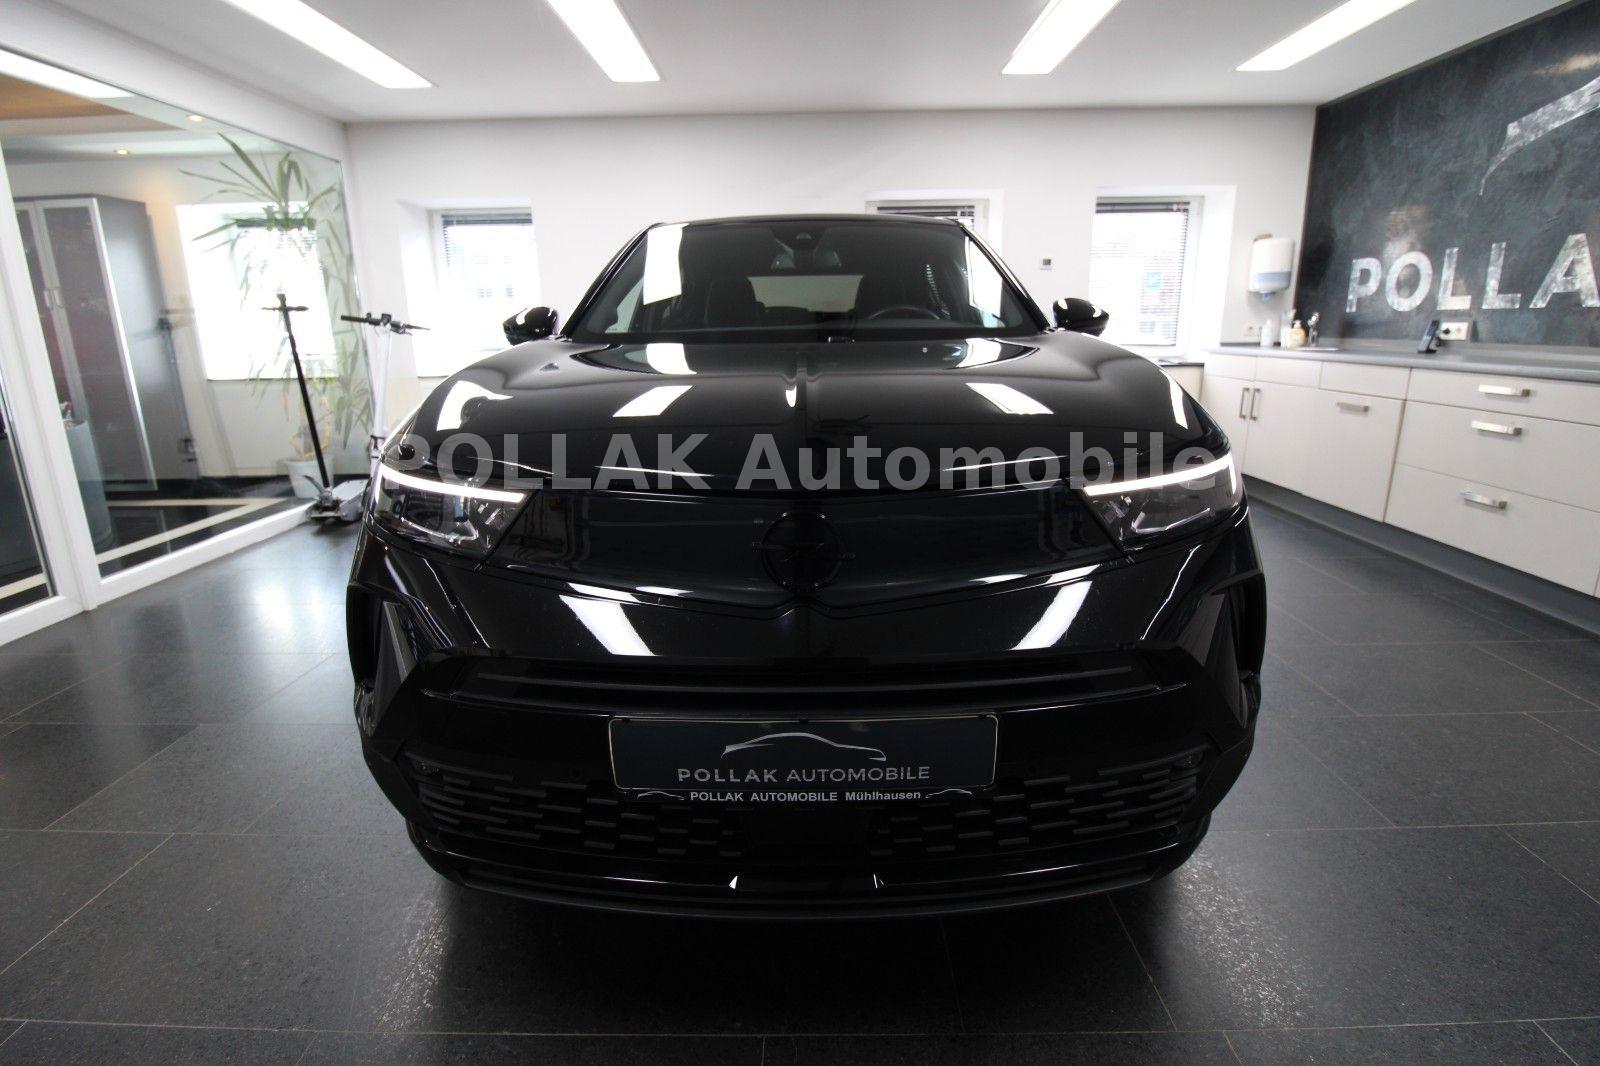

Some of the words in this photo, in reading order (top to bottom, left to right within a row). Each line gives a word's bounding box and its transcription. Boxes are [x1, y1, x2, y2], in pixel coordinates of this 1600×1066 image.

[1346, 233, 1600, 312] POLLA
[677, 768, 778, 782] POLLAK
[786, 766, 930, 782] AUTOMOBILE
[690, 791, 744, 801] POLLAK
[750, 792, 838, 802] AUTOMOBILE
[845, 791, 921, 801] Mühlhausen
